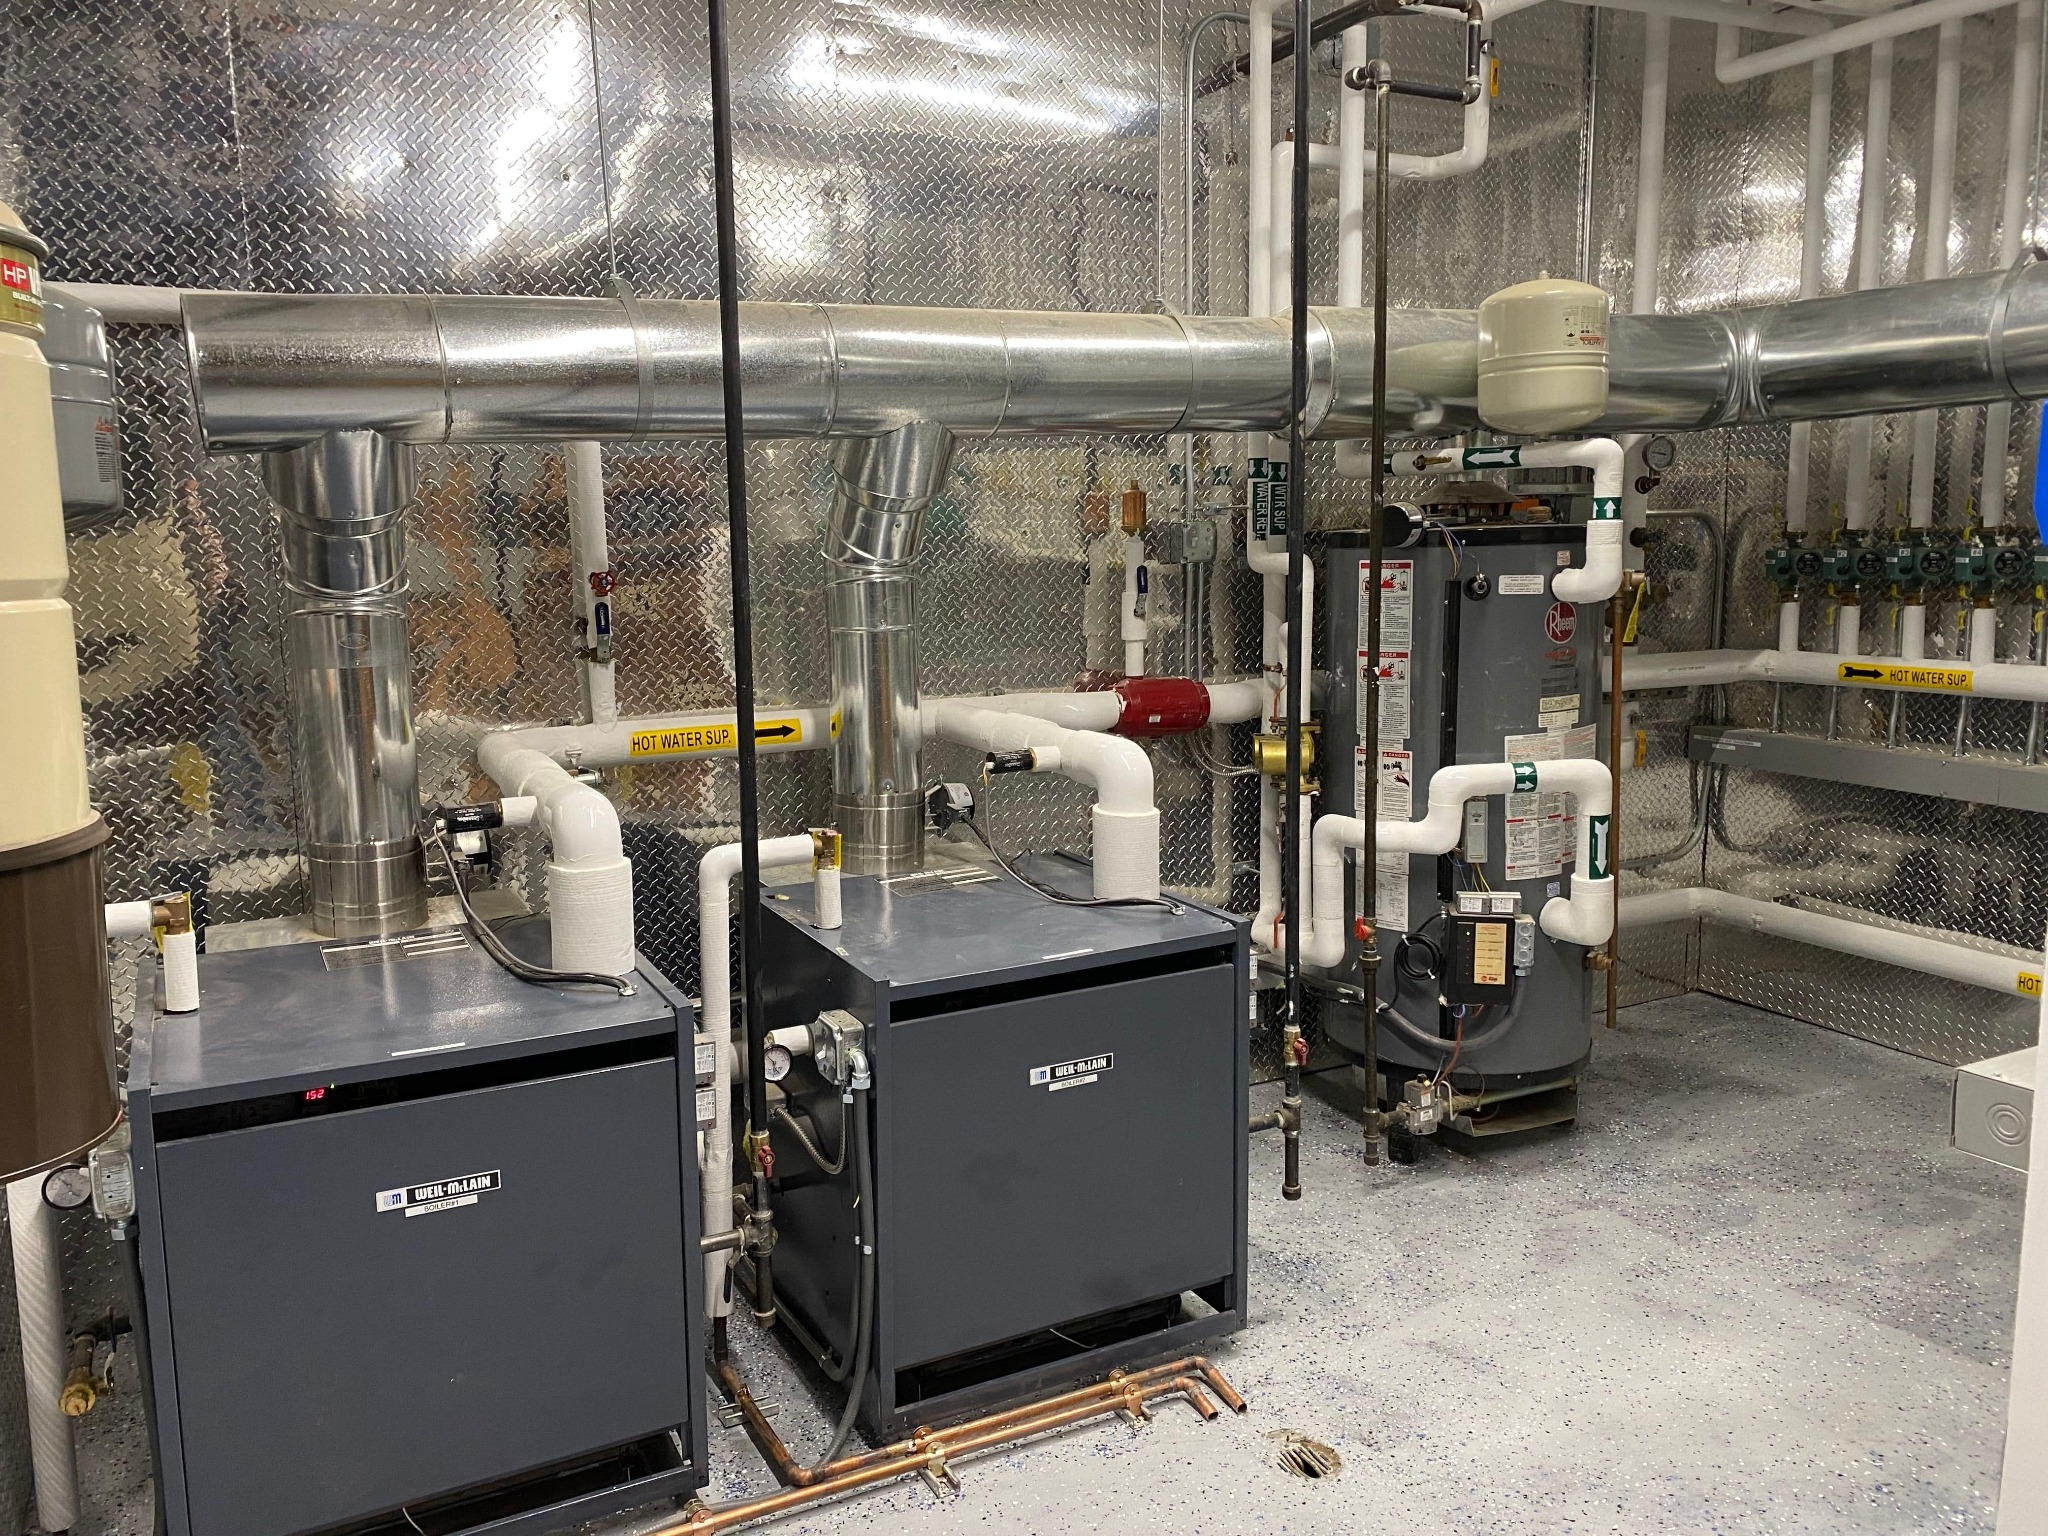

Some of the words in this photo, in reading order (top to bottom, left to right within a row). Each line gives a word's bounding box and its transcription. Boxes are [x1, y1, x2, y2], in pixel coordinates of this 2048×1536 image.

[3, 264, 27, 284] HP
[1257, 483, 1268, 515] WATER
[1274, 486, 1287, 508] WTR
[1273, 510, 1286, 530] SUP
[1549, 603, 1575, 637] Rheem
[1890, 669, 1910, 682] HOT
[1911, 671, 1944, 685] WATER
[1947, 673, 1969, 688] SUP.
[632, 735, 657, 752] HOT
[661, 731, 703, 749] WATER
[706, 729, 731, 745] SUP.
[2018, 975, 2042, 992] HOT
[306, 1089, 325, 1100] 152
